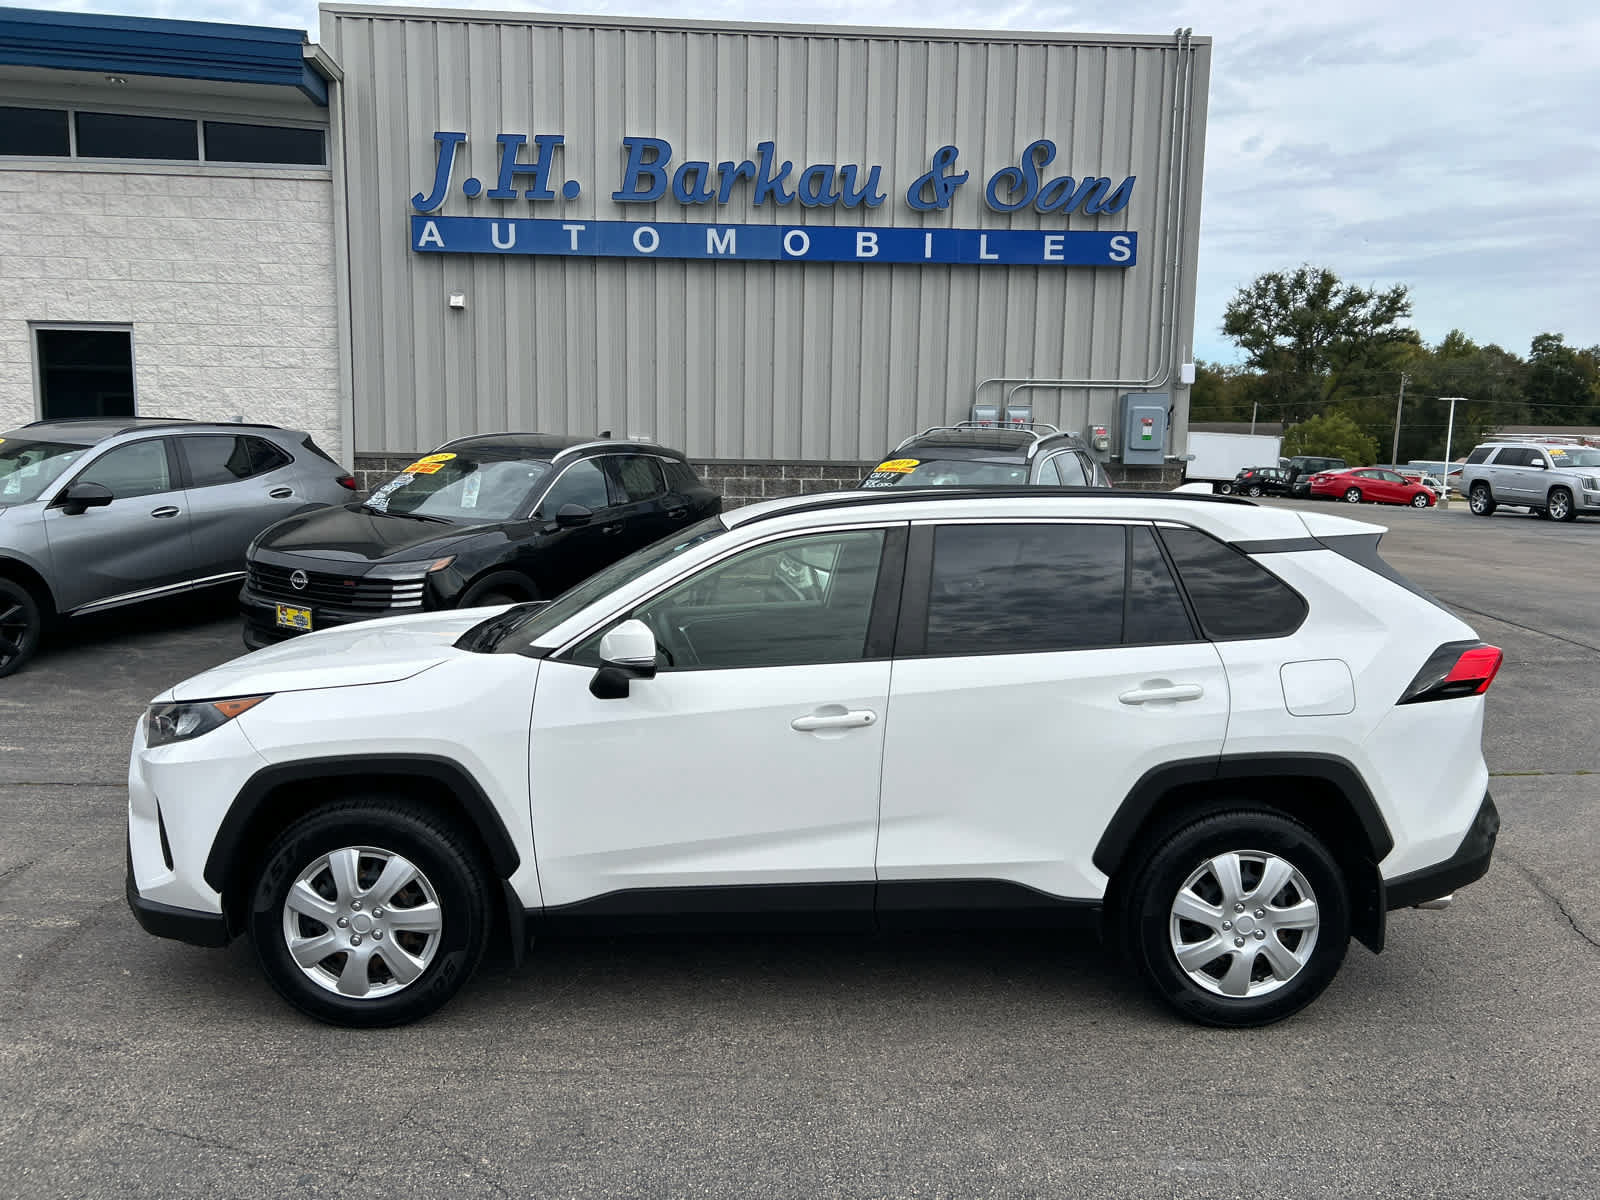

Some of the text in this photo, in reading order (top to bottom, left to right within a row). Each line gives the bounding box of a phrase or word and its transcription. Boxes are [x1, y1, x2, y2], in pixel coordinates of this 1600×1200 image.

[411, 131, 1137, 214] J.H. Barkau & Sons
[418, 221, 1132, 262] AUTOMOBILES
